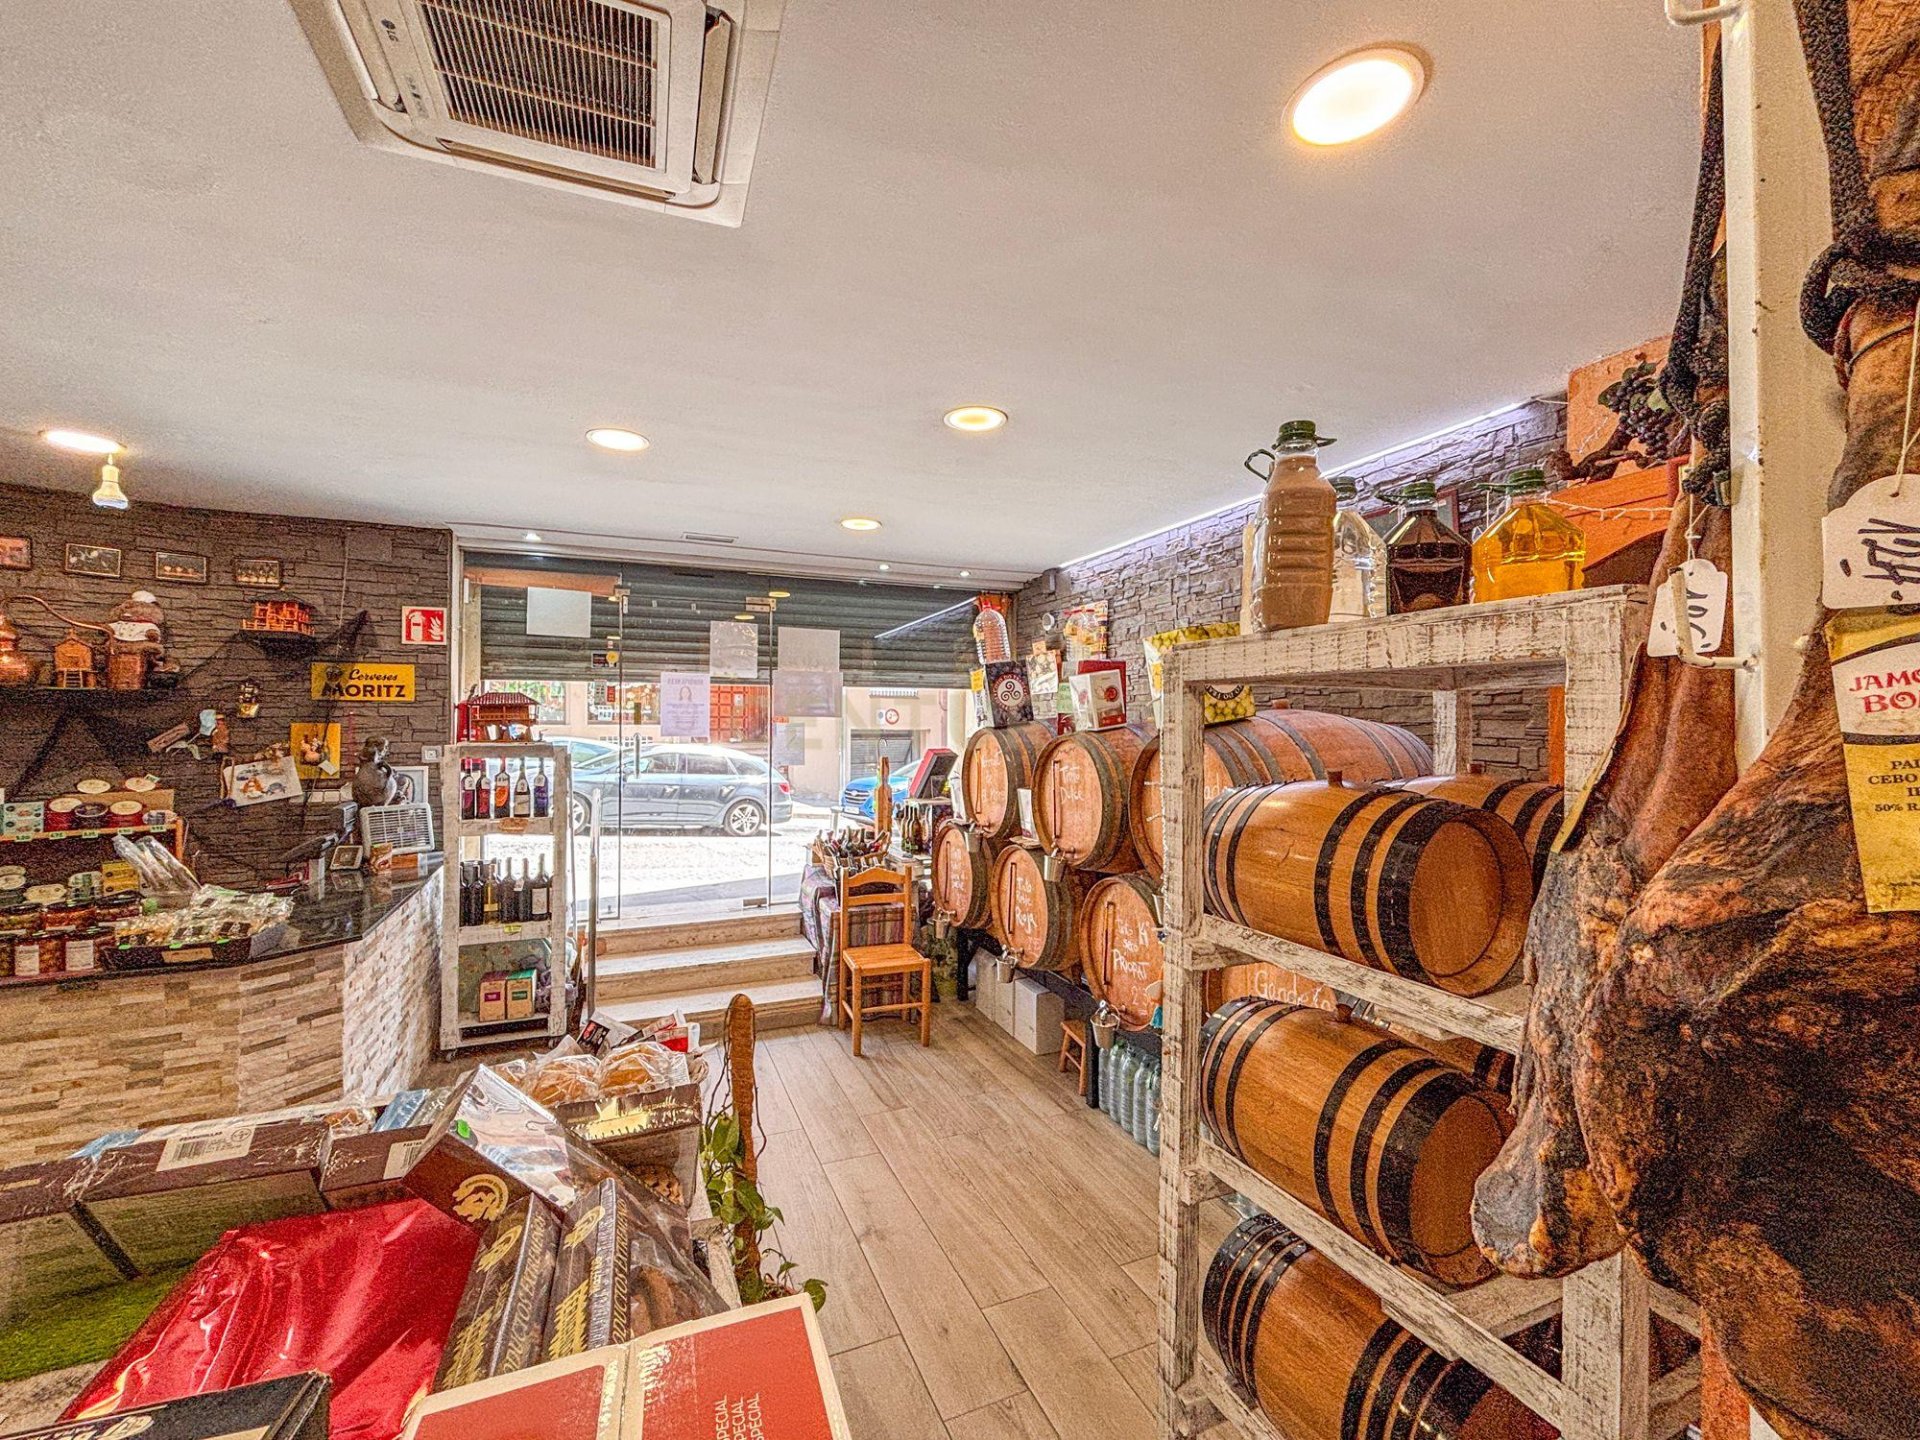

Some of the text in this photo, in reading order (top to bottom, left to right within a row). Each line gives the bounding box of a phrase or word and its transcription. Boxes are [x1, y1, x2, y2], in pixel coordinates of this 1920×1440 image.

[321, 682, 406, 698] MORITZ
[1868, 774, 1918, 785] CEBO
[1874, 803, 1903, 812] 50%
